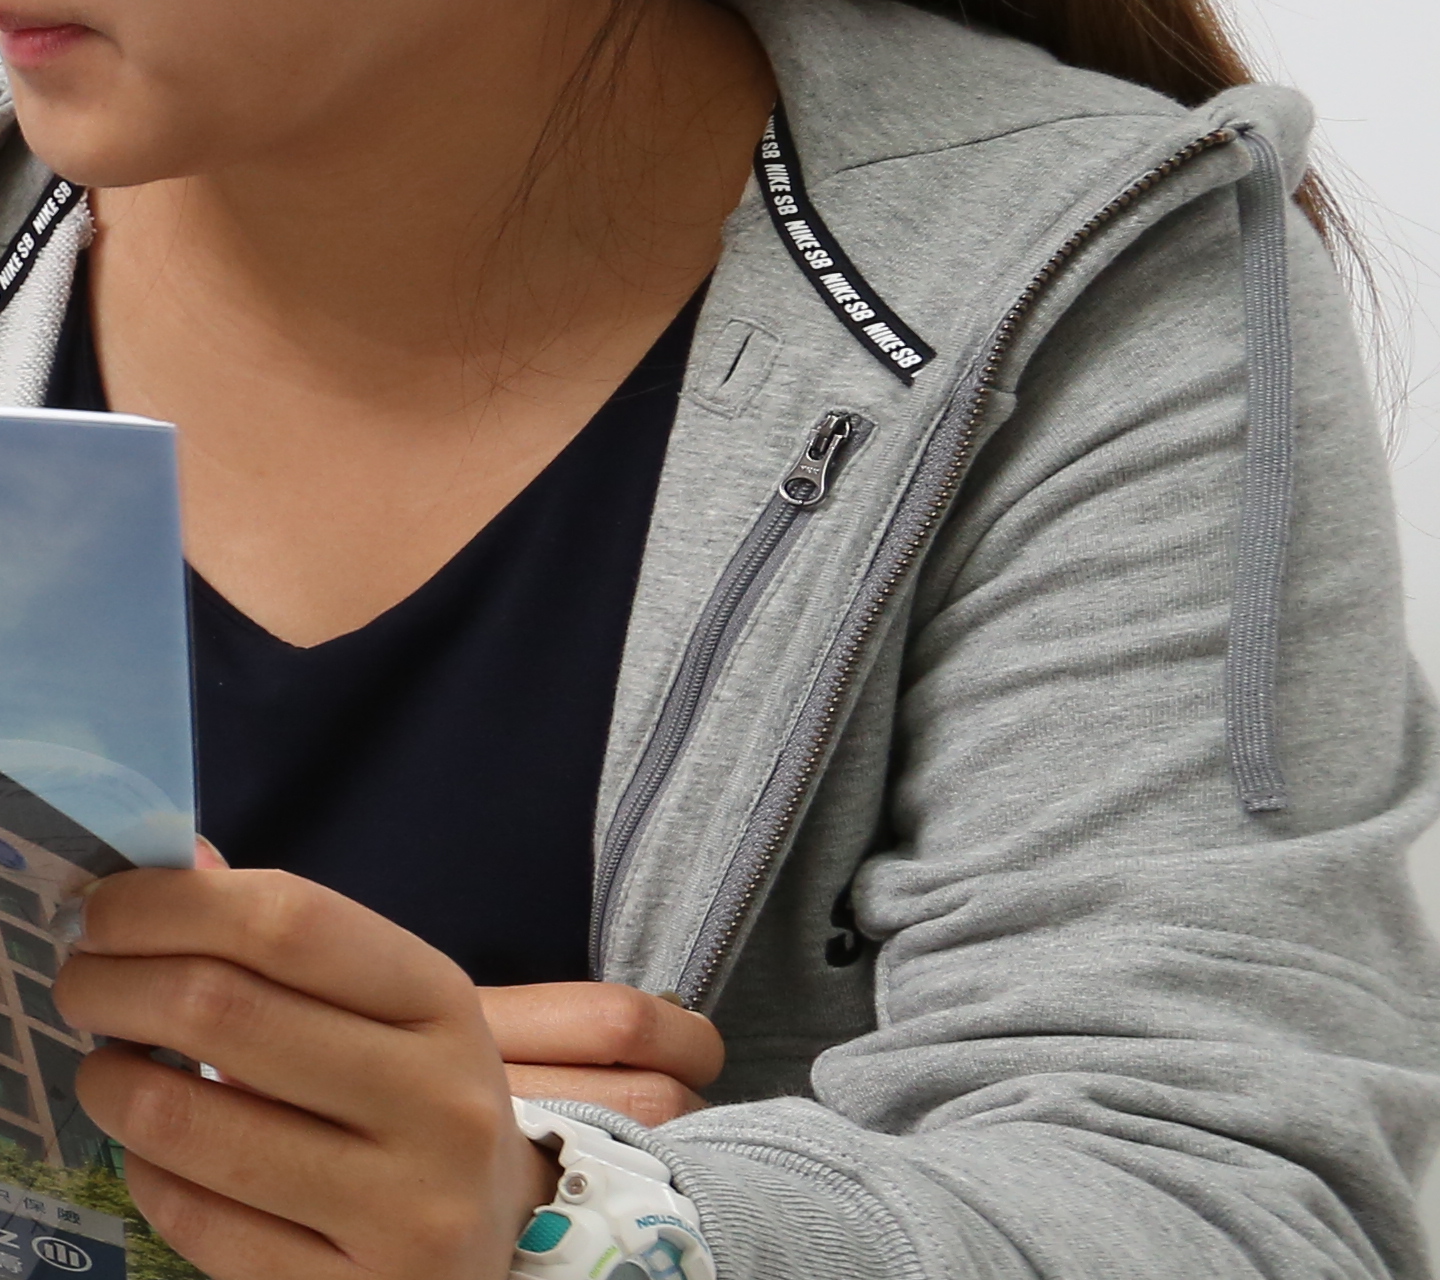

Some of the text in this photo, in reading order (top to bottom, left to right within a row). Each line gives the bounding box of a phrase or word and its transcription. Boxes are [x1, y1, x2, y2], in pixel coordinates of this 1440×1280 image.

[761, 141, 780, 160] SB
[763, 163, 791, 194] NIKE
[18, 231, 36, 259] SB
[32, 198, 60, 235] NIKE
[52, 180, 73, 205] SB
[773, 195, 799, 217] SB
[784, 219, 818, 252] NIKE
[803, 246, 836, 271] SB
[819, 272, 857, 305] NIKE
[843, 300, 878, 323] SB
[862, 321, 902, 354] NIKE
[890, 346, 924, 370] SB
